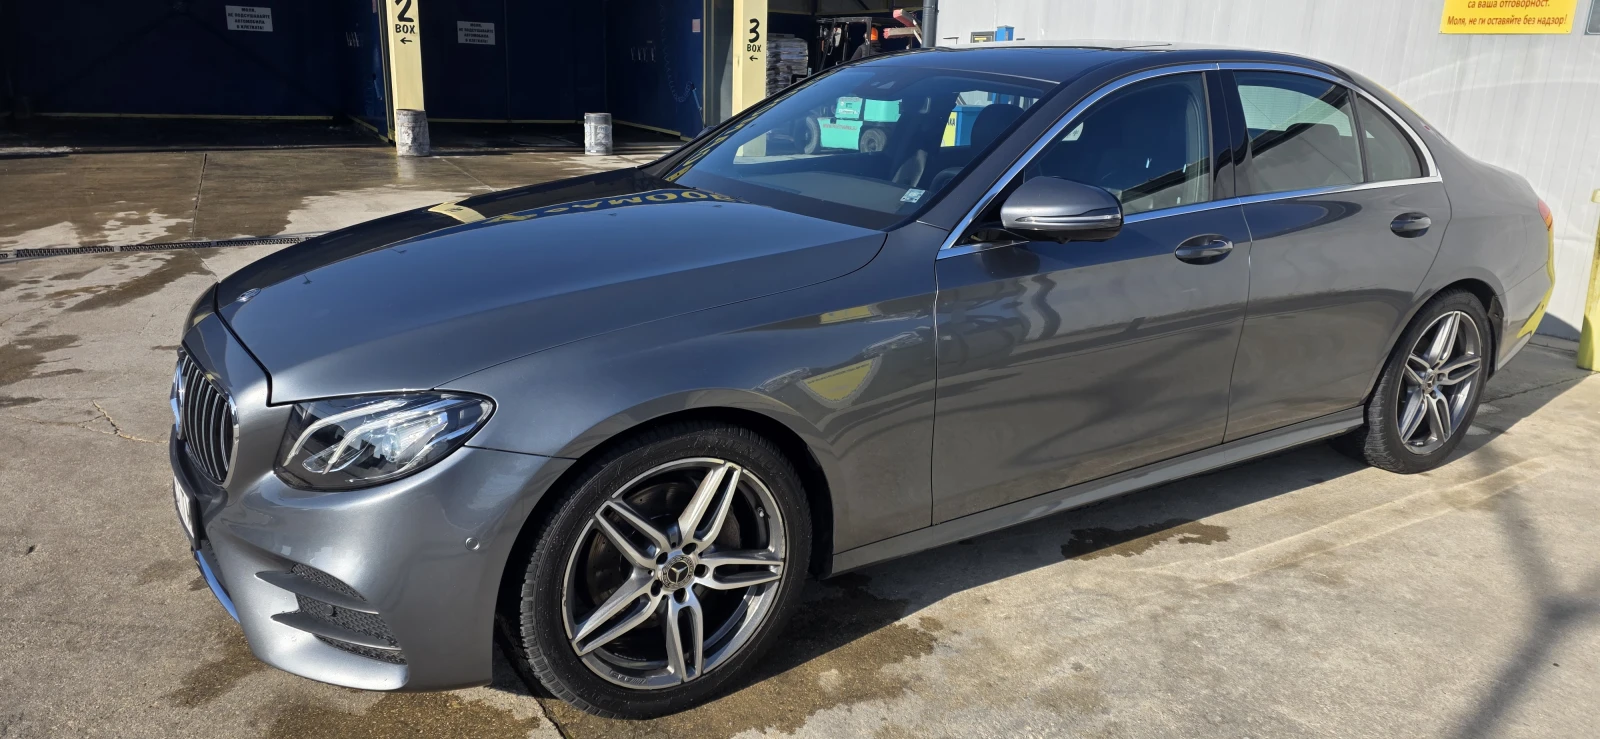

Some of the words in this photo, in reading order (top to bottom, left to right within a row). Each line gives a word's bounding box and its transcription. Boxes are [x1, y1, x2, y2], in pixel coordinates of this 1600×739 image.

[1467, 0, 1476, 8] са
[1477, 0, 1498, 8] ваша
[1499, 0, 1550, 10] отговорност.
[394, 0, 414, 22] 2
[1447, 16, 1467, 27] Моля,
[1468, 17, 1477, 25] не
[1478, 17, 1486, 25] ги
[1487, 14, 1522, 25] оставяйте
[1523, 14, 1536, 25] без
[1537, 14, 1568, 27] надзор!
[395, 24, 415, 34] BOX
[748, 18, 760, 43] 3
[746, 43, 762, 52] BOX
